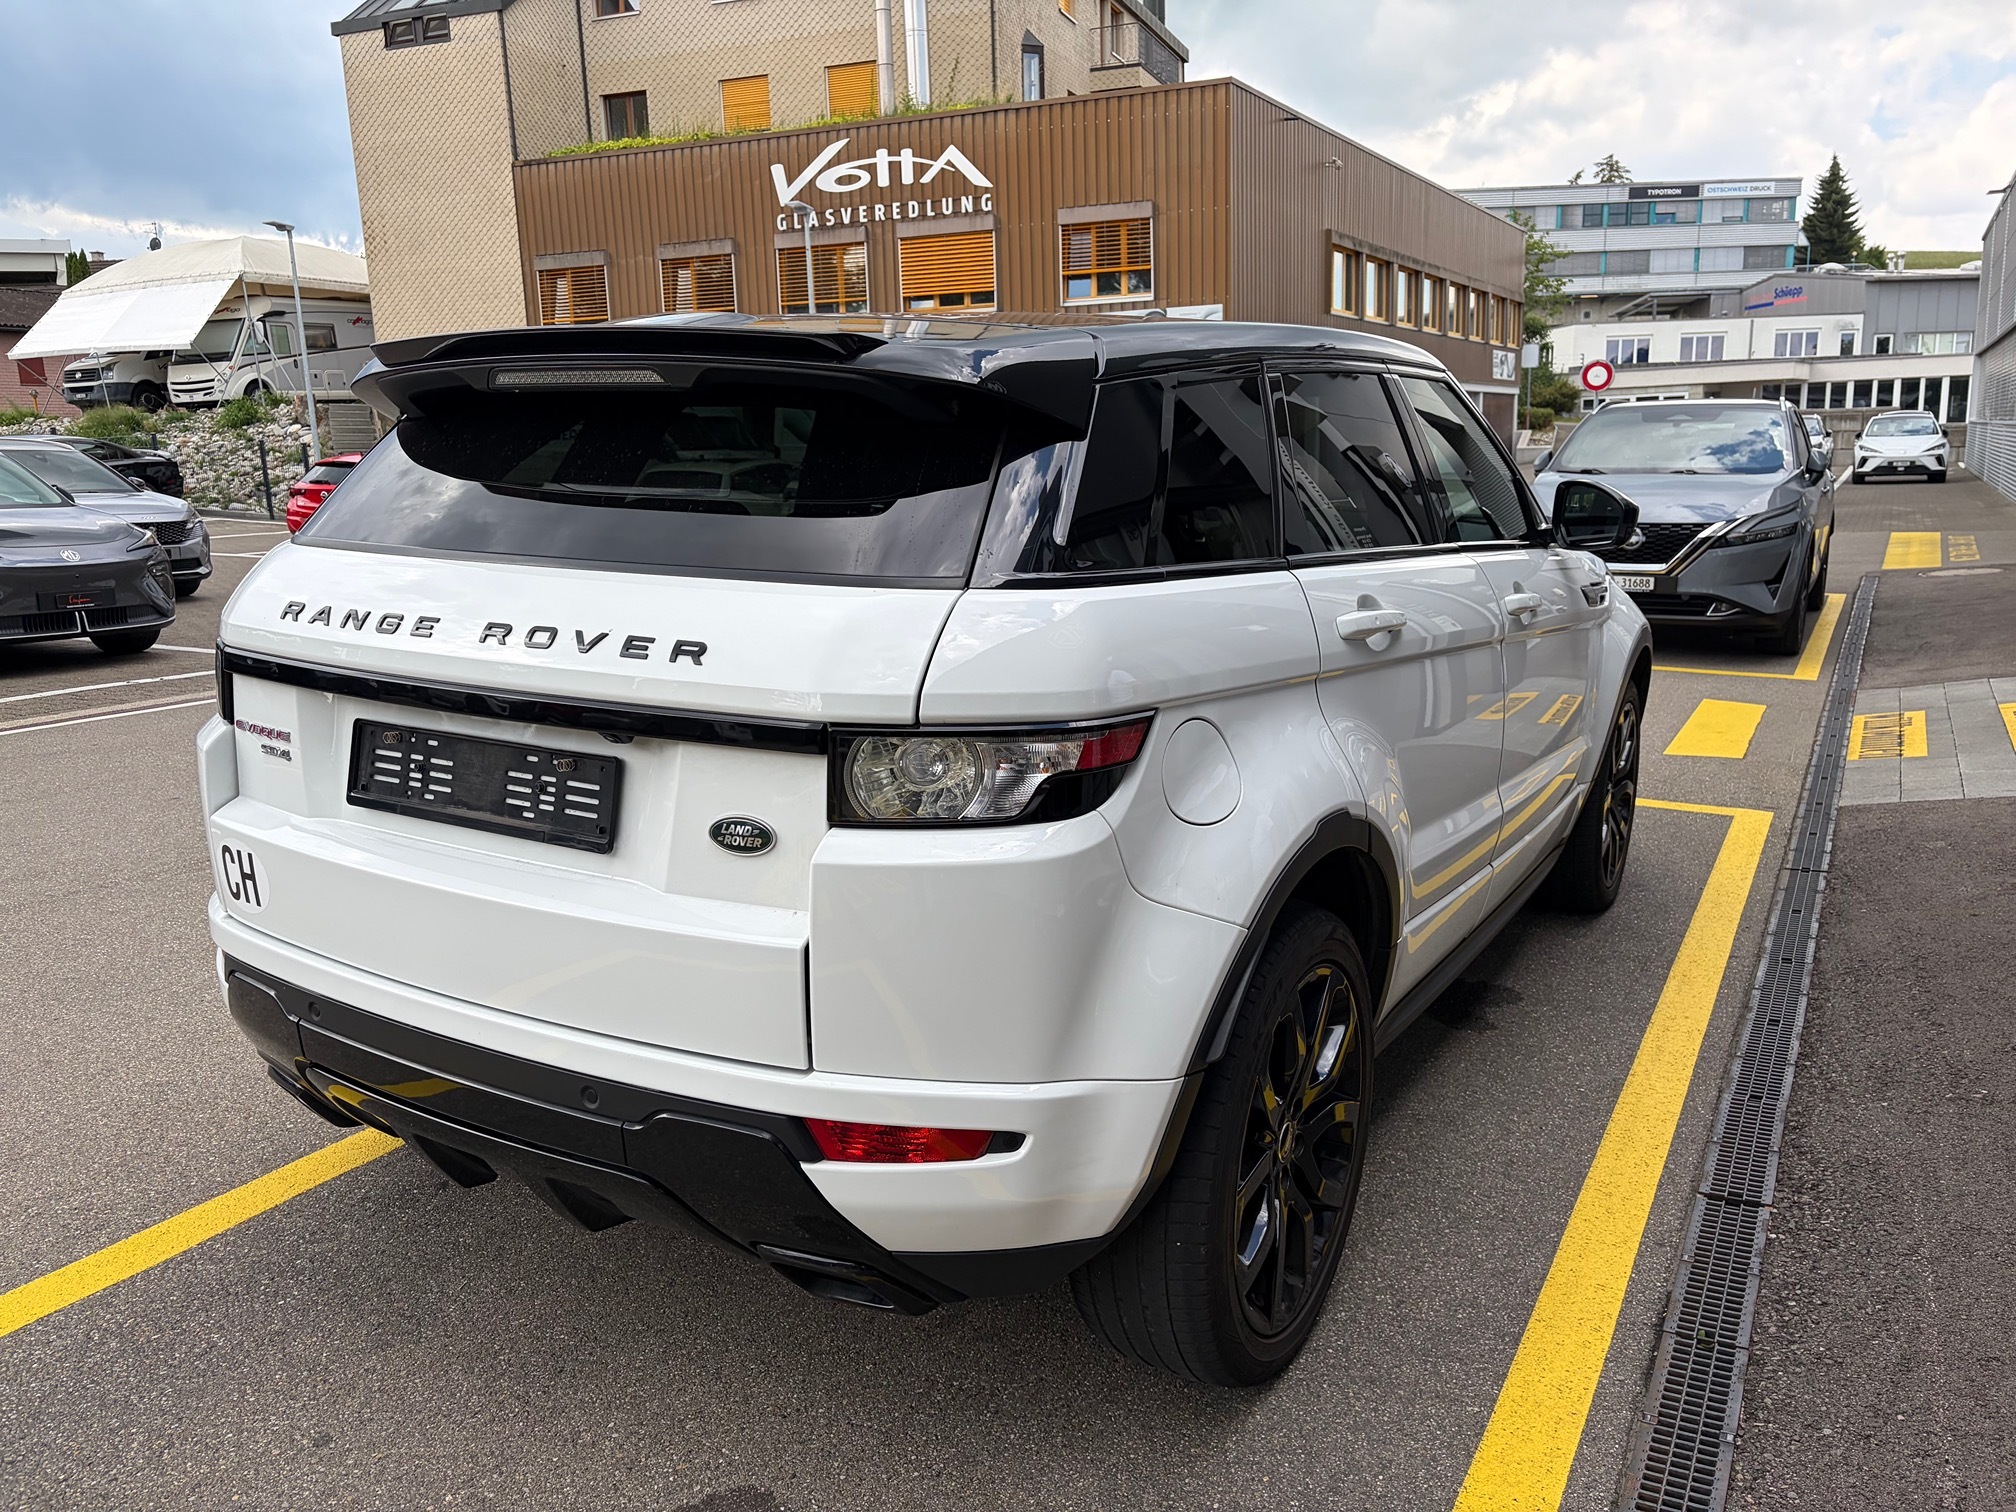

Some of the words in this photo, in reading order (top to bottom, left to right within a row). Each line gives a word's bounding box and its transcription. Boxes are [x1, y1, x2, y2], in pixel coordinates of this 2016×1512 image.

[1647, 188, 1682, 196] TYPOTRON
[1706, 186, 1748, 194] OSTSCHWEIZ
[776, 193, 993, 231] GLASVEREDLUNG
[1621, 577, 1651, 588] 31688
[280, 600, 441, 638] RANGE
[479, 622, 709, 666] ROVER
[721, 823, 752, 836] LAND
[724, 834, 763, 848] ROVER
[221, 841, 263, 908] CH
